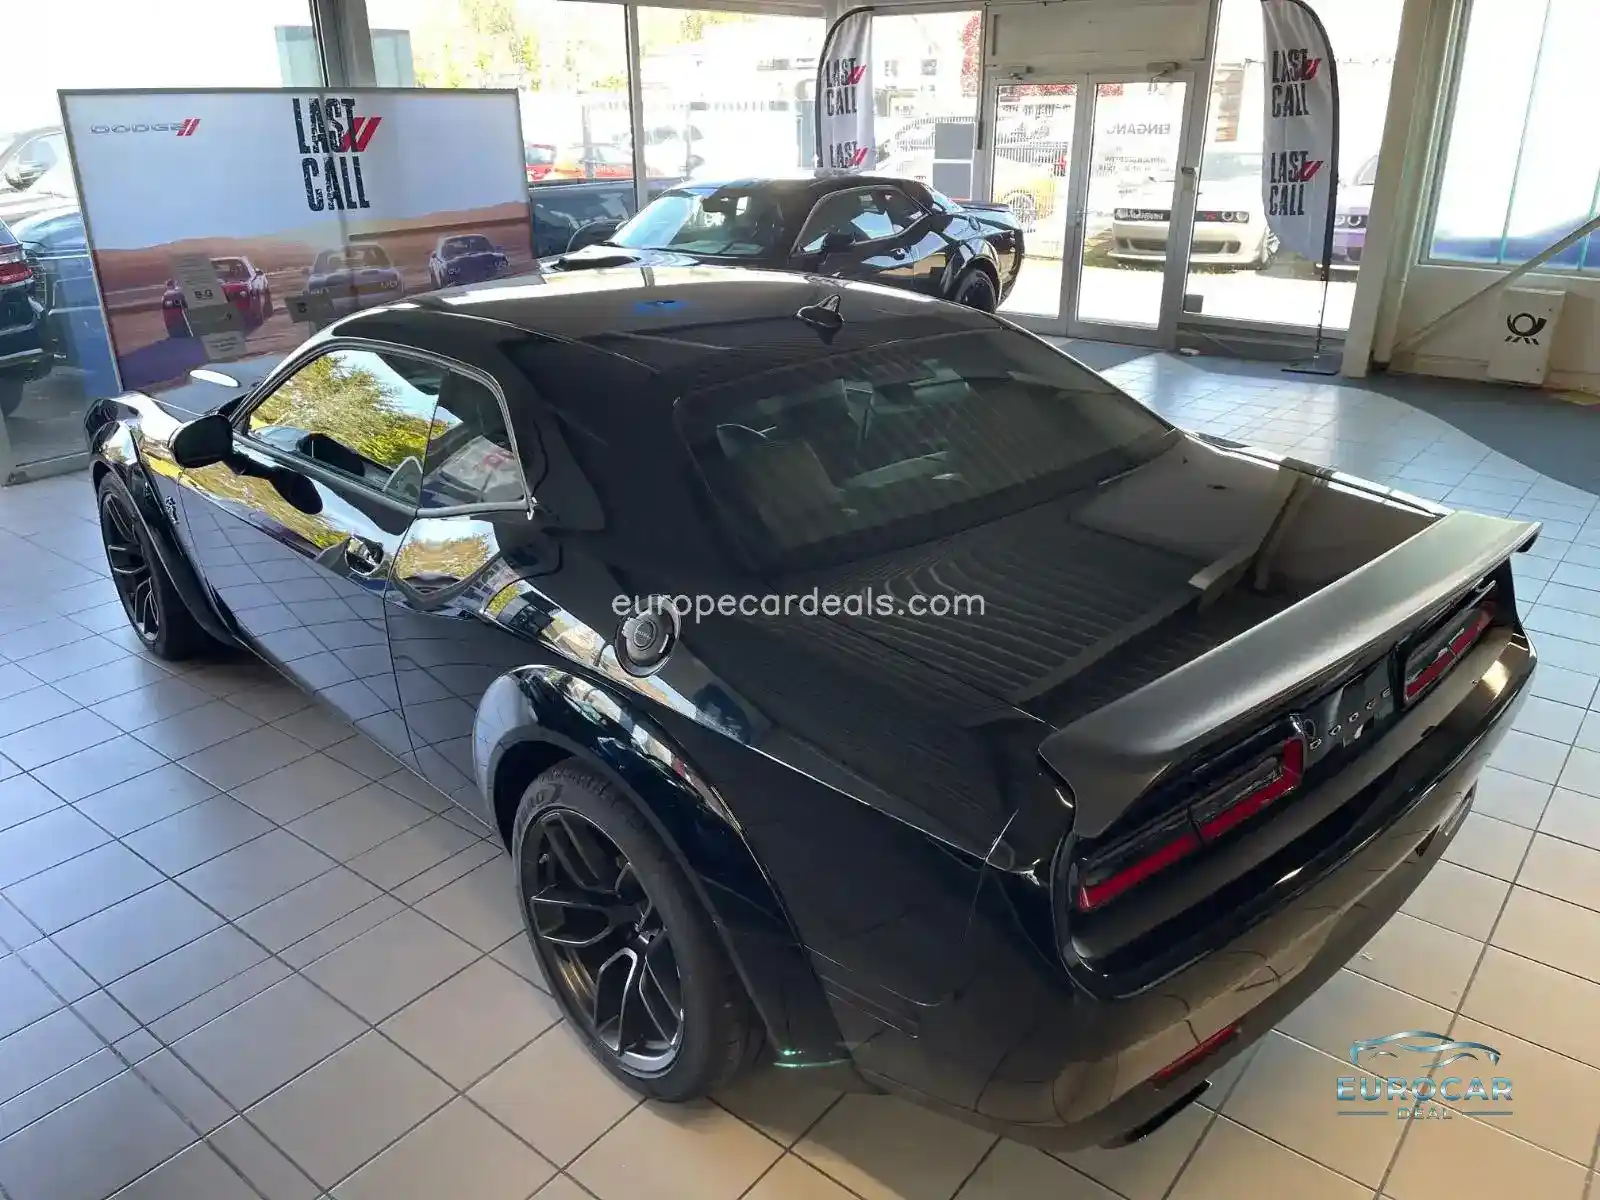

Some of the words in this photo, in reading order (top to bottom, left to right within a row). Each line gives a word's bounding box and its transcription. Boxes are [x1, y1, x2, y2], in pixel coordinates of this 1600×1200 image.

[826, 57, 857, 88] LAST
[1271, 48, 1309, 84] LAST
[826, 87, 857, 116] CALL
[1271, 82, 1310, 118] CALL
[90, 122, 184, 135] DODGE
[292, 98, 357, 154] LAST
[829, 141, 858, 169] LAST
[1269, 150, 1309, 184] LAST
[301, 155, 371, 212] CALL
[1268, 184, 1305, 216] CALL
[1309, 687, 1392, 751] DODGE
